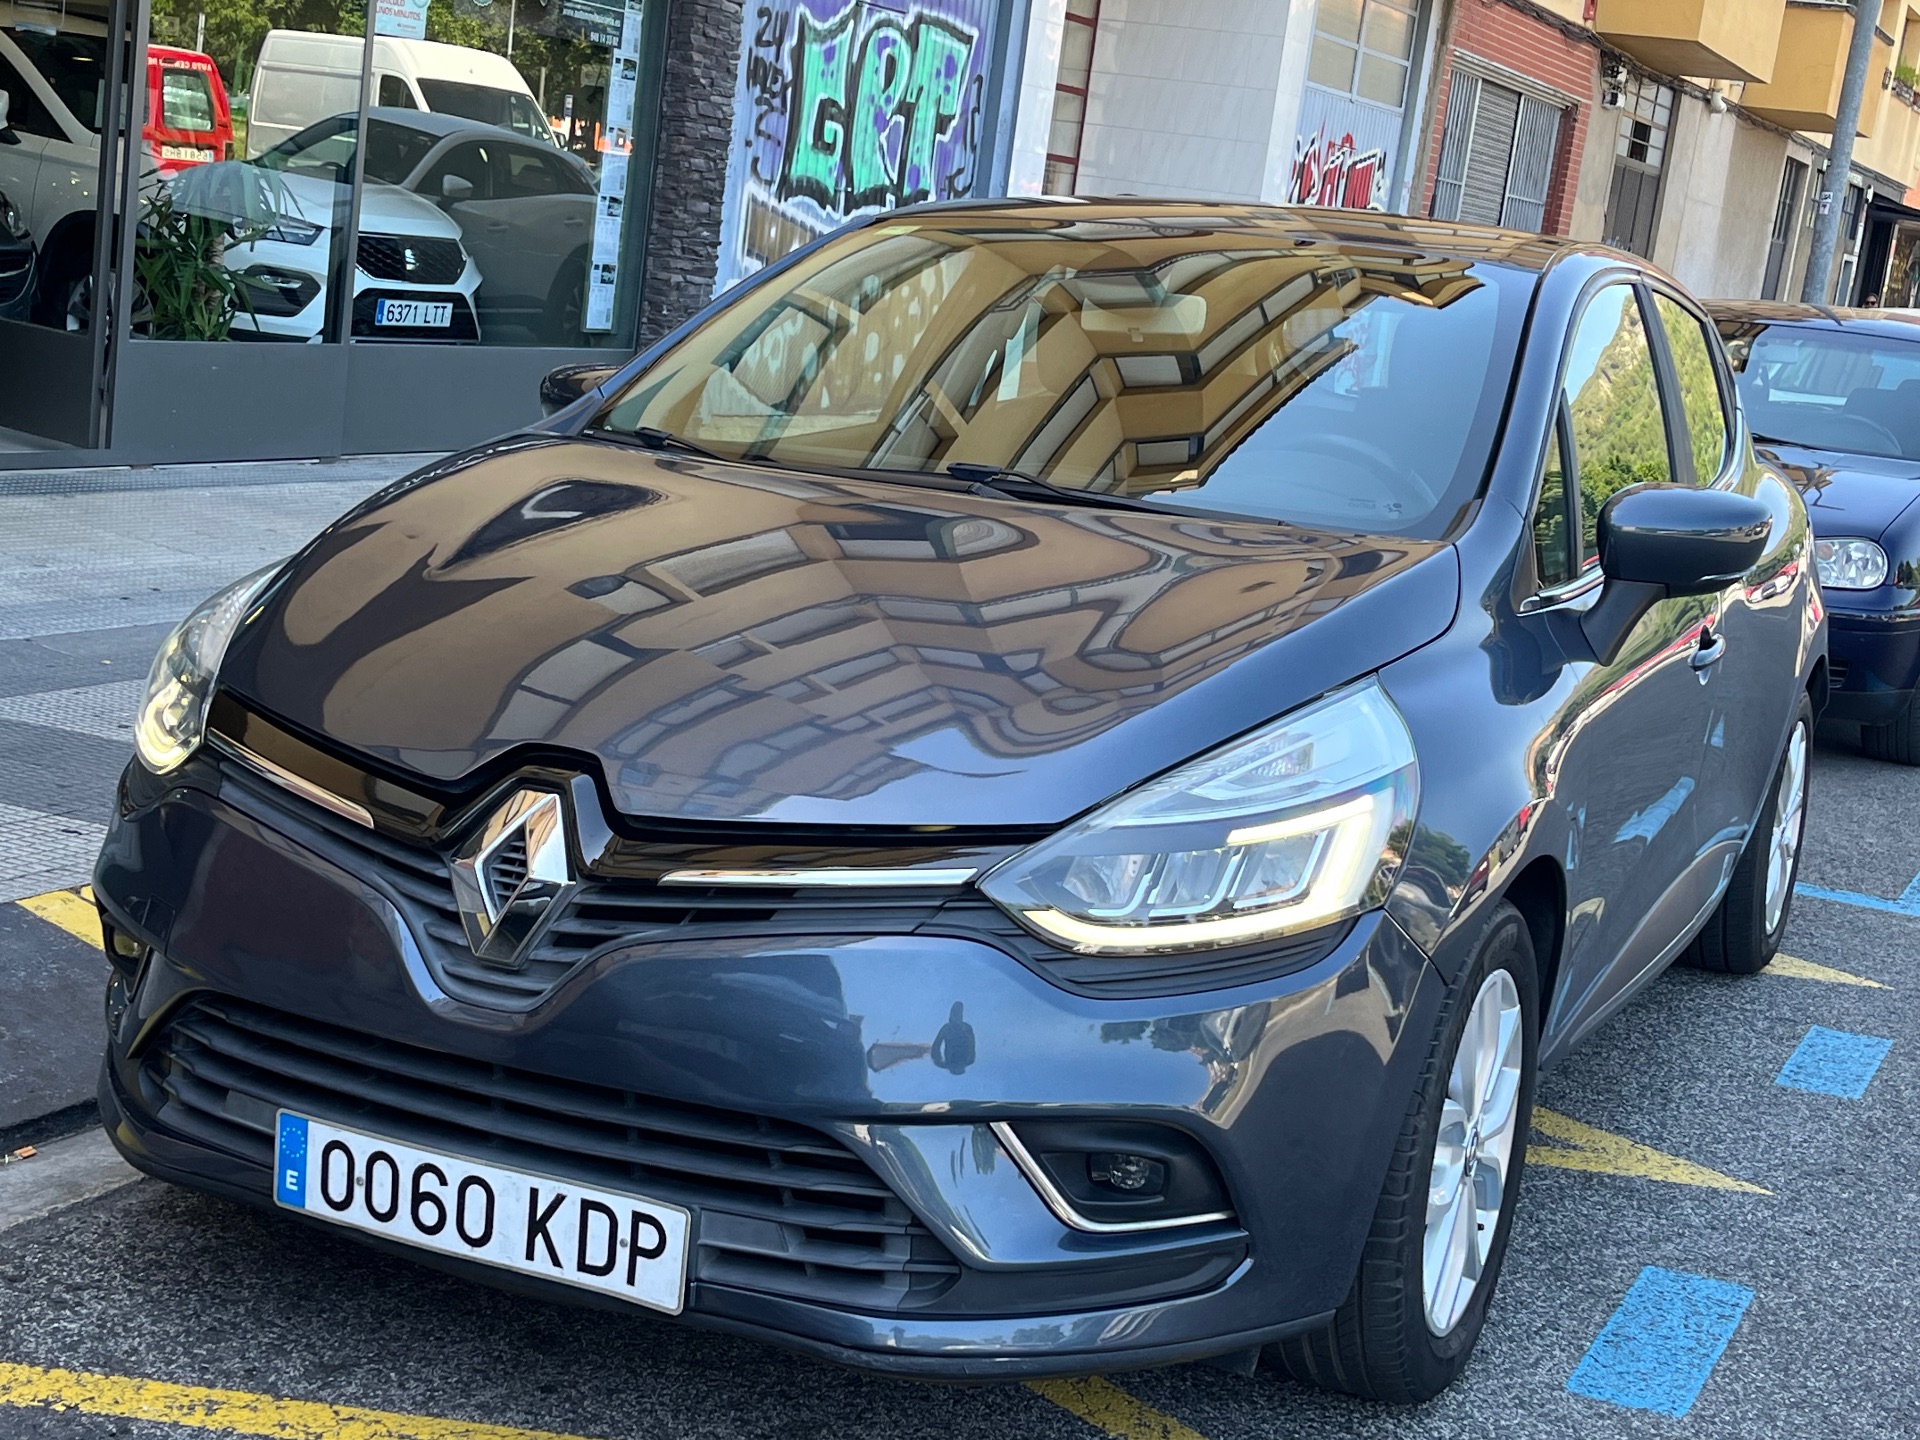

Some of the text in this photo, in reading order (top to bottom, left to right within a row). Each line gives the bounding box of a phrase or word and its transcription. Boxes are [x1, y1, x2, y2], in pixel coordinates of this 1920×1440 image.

[393, 9, 421, 21] MINUTOS
[386, 303, 448, 324] 6371 LTT
[285, 1169, 299, 1191] E
[320, 1140, 667, 1287] 0060 KDP
